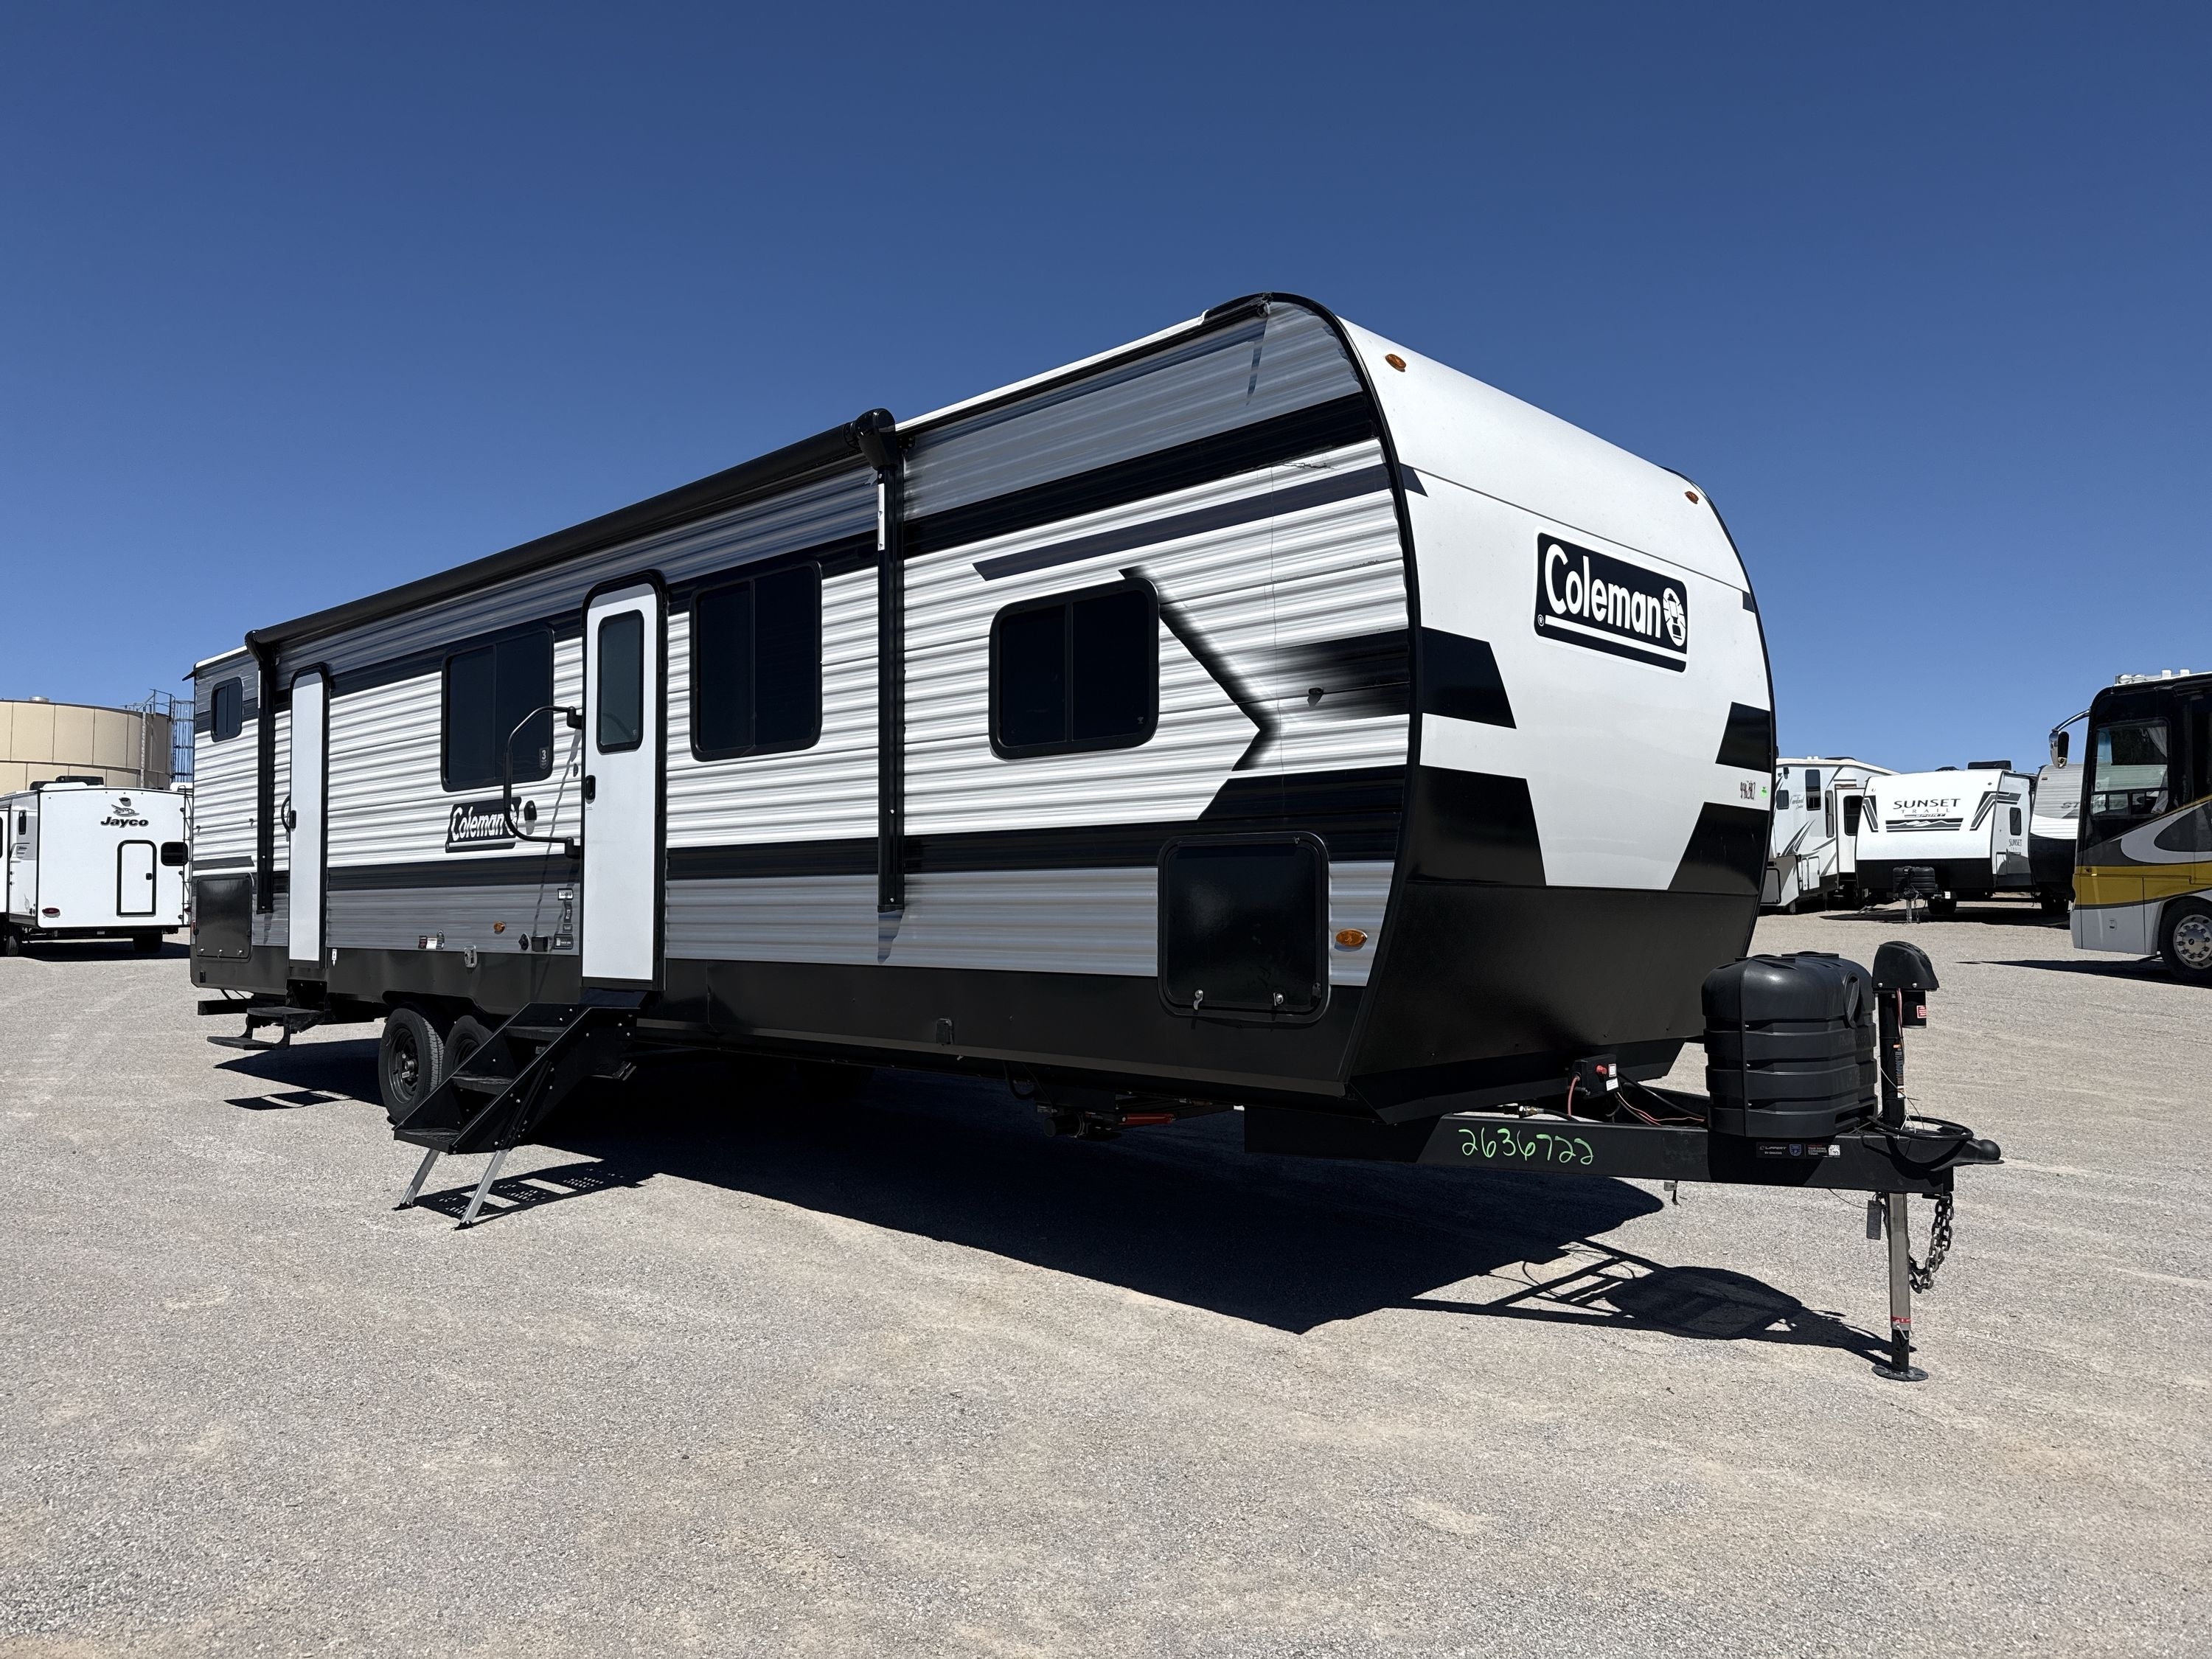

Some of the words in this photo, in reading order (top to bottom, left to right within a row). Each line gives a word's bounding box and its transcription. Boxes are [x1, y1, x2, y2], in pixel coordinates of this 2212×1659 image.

[1545, 543, 1661, 639] Coleman
[541, 749, 546, 760] 3
[1893, 799, 1961, 810] SUNSET
[100, 816, 149, 829] Jayco
[451, 806, 504, 841] Coleman
[2009, 838, 2023, 847] SUNSET
[1458, 1127, 1594, 1165] 2636722
